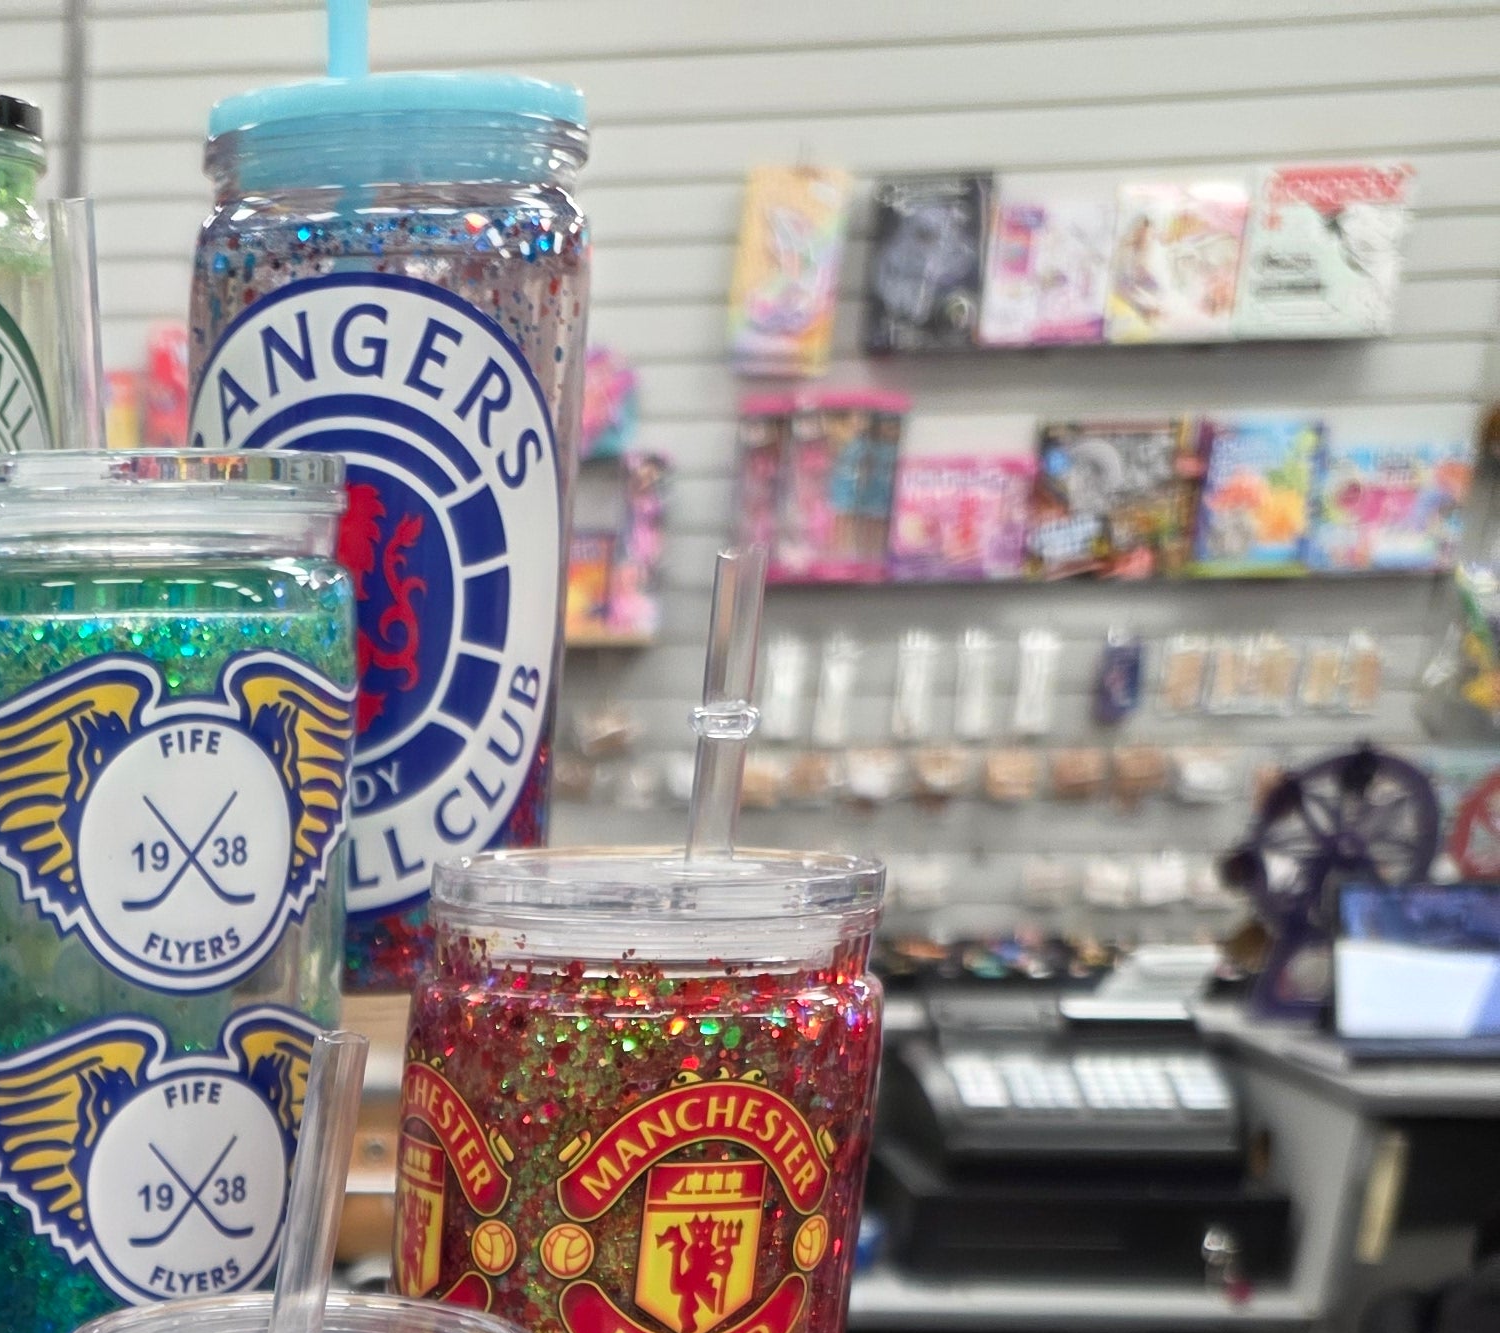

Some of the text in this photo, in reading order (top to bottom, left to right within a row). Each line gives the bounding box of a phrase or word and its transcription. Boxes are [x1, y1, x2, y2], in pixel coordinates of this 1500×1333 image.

[194, 303, 542, 490] ANGERS
[159, 728, 221, 760] FIFE
[433, 663, 540, 842] CLUB
[131, 836, 248, 873] 19 38
[142, 929, 242, 965] FLYERS
[164, 1081, 222, 1110] FIFE
[407, 1075, 493, 1196] CHESTER
[580, 1096, 817, 1203] MANCHESTER
[137, 1176, 246, 1213] 19 38
[148, 1259, 241, 1295] FLYERS
